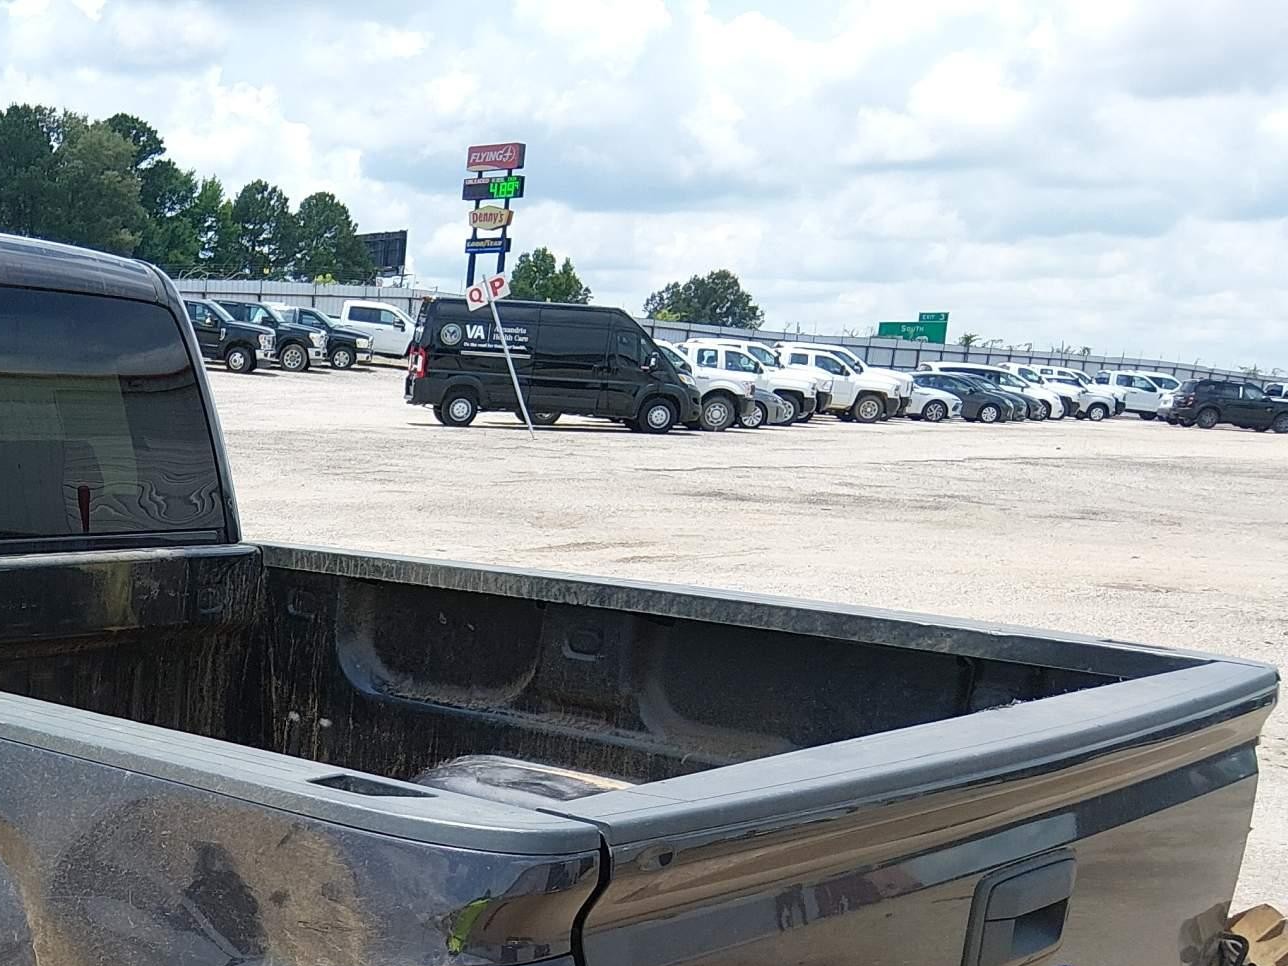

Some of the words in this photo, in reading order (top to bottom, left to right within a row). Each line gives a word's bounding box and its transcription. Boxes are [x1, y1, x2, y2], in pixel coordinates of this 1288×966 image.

[470, 151, 504, 163] FLYING
[472, 211, 505, 225] Denny's
[489, 277, 505, 298] P
[469, 287, 485, 303] Q
[465, 325, 485, 339] VA
